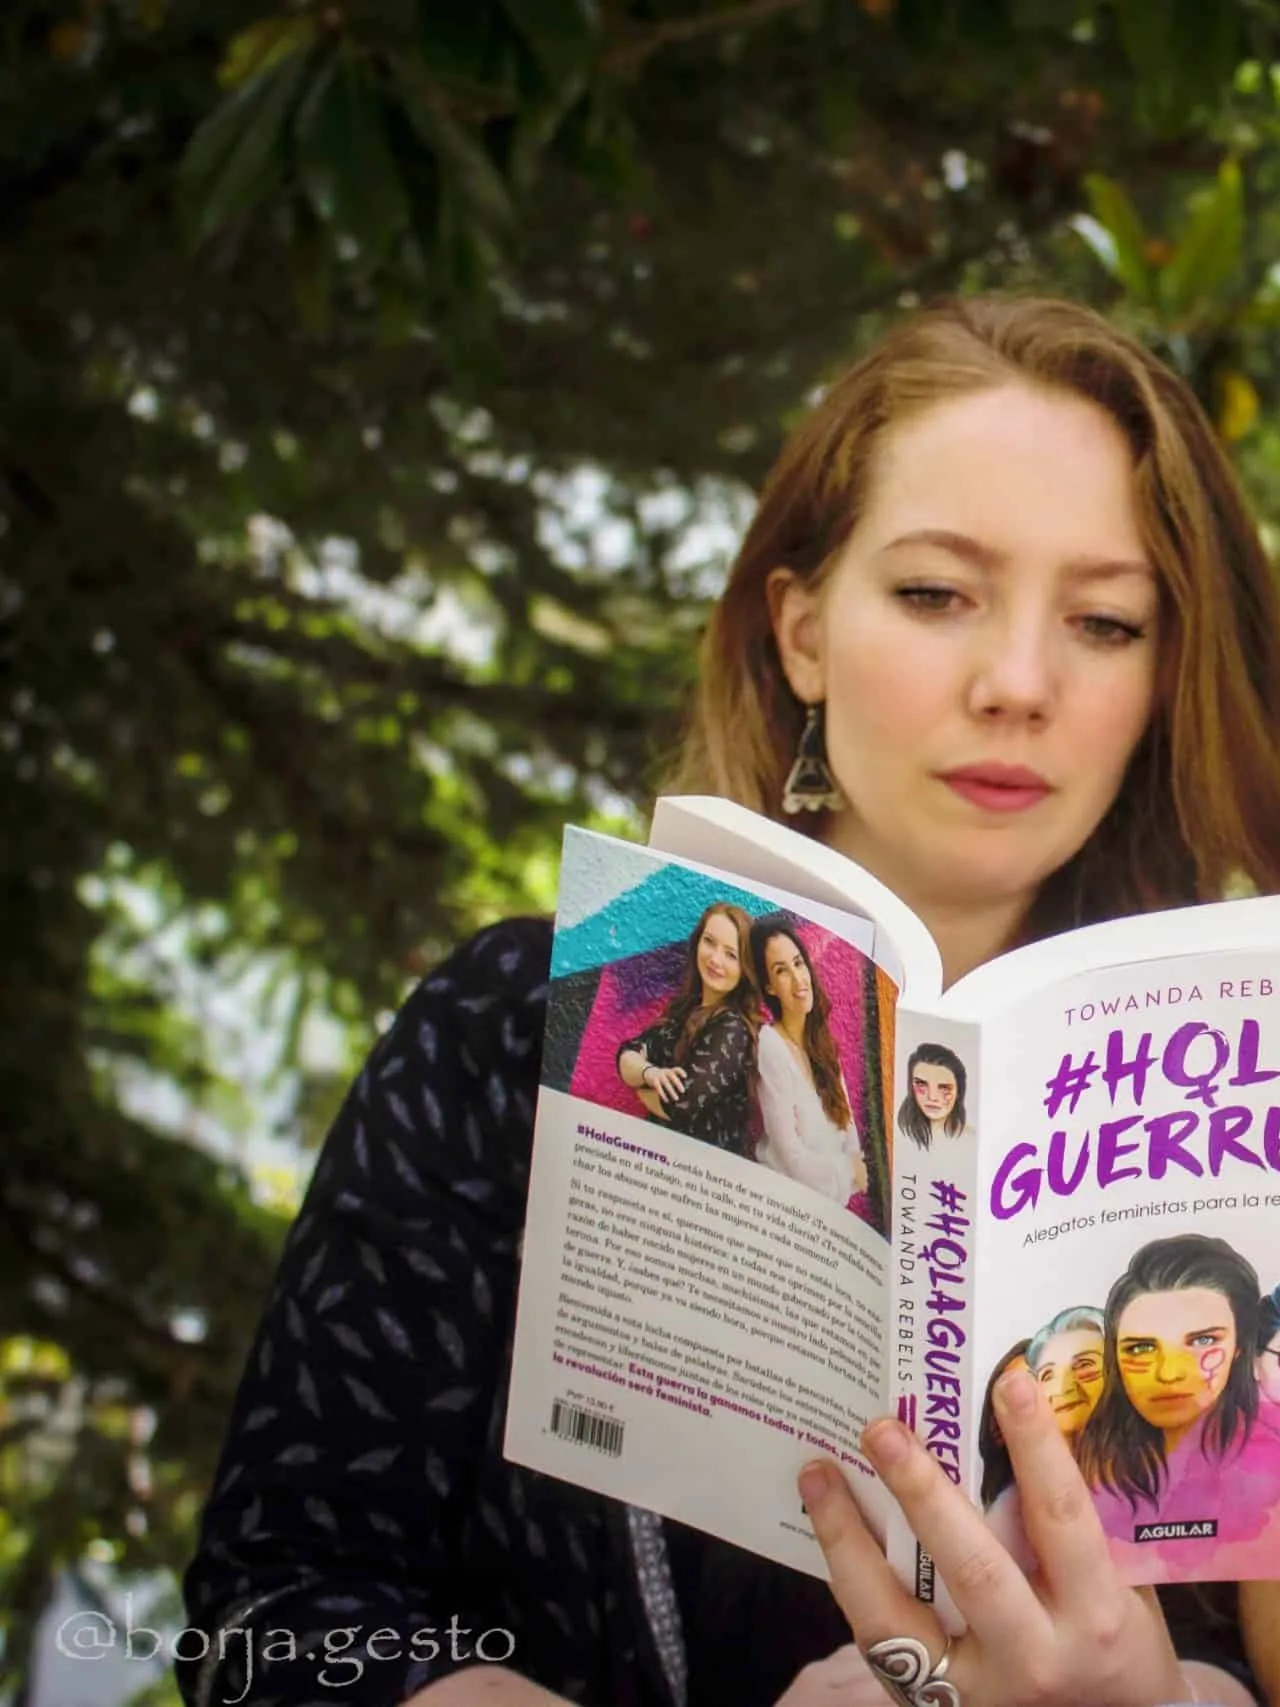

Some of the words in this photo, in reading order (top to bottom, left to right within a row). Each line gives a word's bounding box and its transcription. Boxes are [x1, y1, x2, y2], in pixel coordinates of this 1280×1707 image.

[1065, 986, 1203, 1026] TOWANDA
[577, 1123, 670, 1166] #HolaGuerrera,
[706, 1169, 732, 1189] harta
[735, 1183, 747, 1194] de
[584, 1183, 594, 1194] tu
[727, 1236, 744, 1248] que
[598, 1163, 611, 1177] los
[650, 1185, 668, 1196] que
[722, 1211, 759, 1232] mujeres
[598, 1220, 609, 1231] de
[619, 1158, 631, 1168] en
[634, 1161, 643, 1172] el
[645, 1165, 682, 1187] trabajo,
[685, 1181, 697, 1191] en
[700, 1183, 709, 1196] la
[739, 1202, 750, 1213] en
[753, 1207, 763, 1218] tu
[766, 1213, 786, 1228] vida
[1023, 1215, 1096, 1247] Alegatos
[1100, 1199, 1188, 1225] feministas
[1193, 1195, 1237, 1214] para
[1243, 1193, 1259, 1208] la
[602, 1207, 614, 1216] no
[741, 1256, 767, 1274] todas
[900, 1174, 916, 1286] TOWANDA
[623, 1279, 658, 1296] porque
[751, 1326, 785, 1344] porque
[898, 1298, 914, 1381] REBELS
[917, 1180, 970, 1486] #HOLAGUERRER
[553, 1351, 564, 1364] la
[566, 1357, 626, 1386] revolución
[628, 1380, 654, 1396] será
[656, 1385, 712, 1417] feminista.
[670, 1348, 682, 1359] de
[727, 1354, 742, 1366] por
[745, 1359, 783, 1383] batallas
[785, 1376, 796, 1387] de
[628, 1361, 654, 1381] Esta
[656, 1374, 695, 1395] guerra
[697, 1386, 708, 1400] la
[709, 1394, 761, 1421] ganamos
[763, 1413, 795, 1435] todas
[797, 1429, 804, 1440] y
[806, 1431, 839, 1456] todos,
[841, 1451, 877, 1477] porque
[1138, 1523, 1214, 1539] AGUILAR
